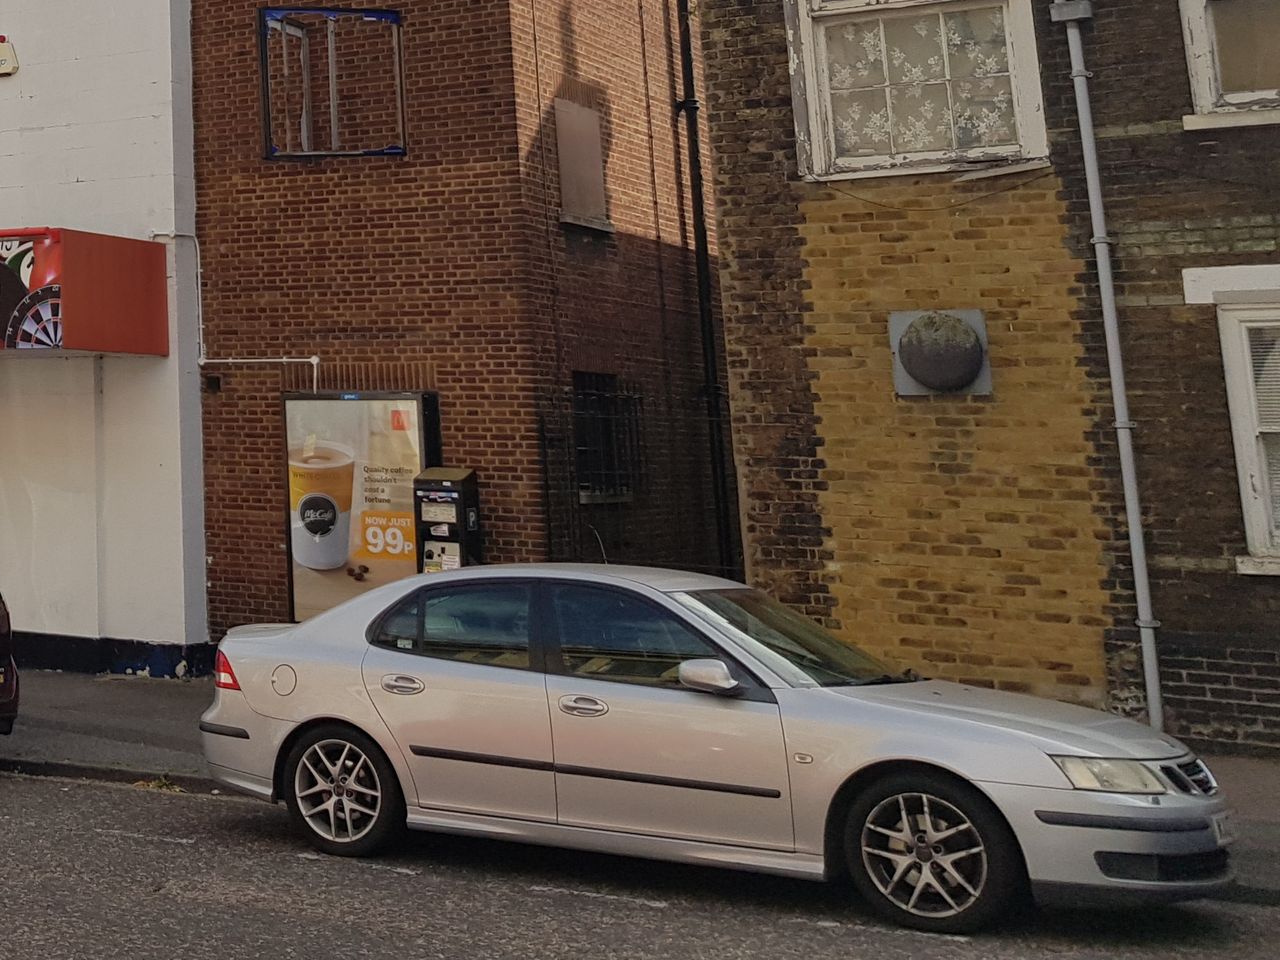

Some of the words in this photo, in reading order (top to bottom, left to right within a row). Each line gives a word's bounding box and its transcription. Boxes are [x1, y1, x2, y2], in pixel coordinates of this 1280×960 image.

[363, 465, 389, 475] Quality
[390, 466, 413, 474] coffee
[364, 476, 397, 484] shouldn't
[365, 516, 387, 525] NOW
[388, 517, 412, 527] JUST
